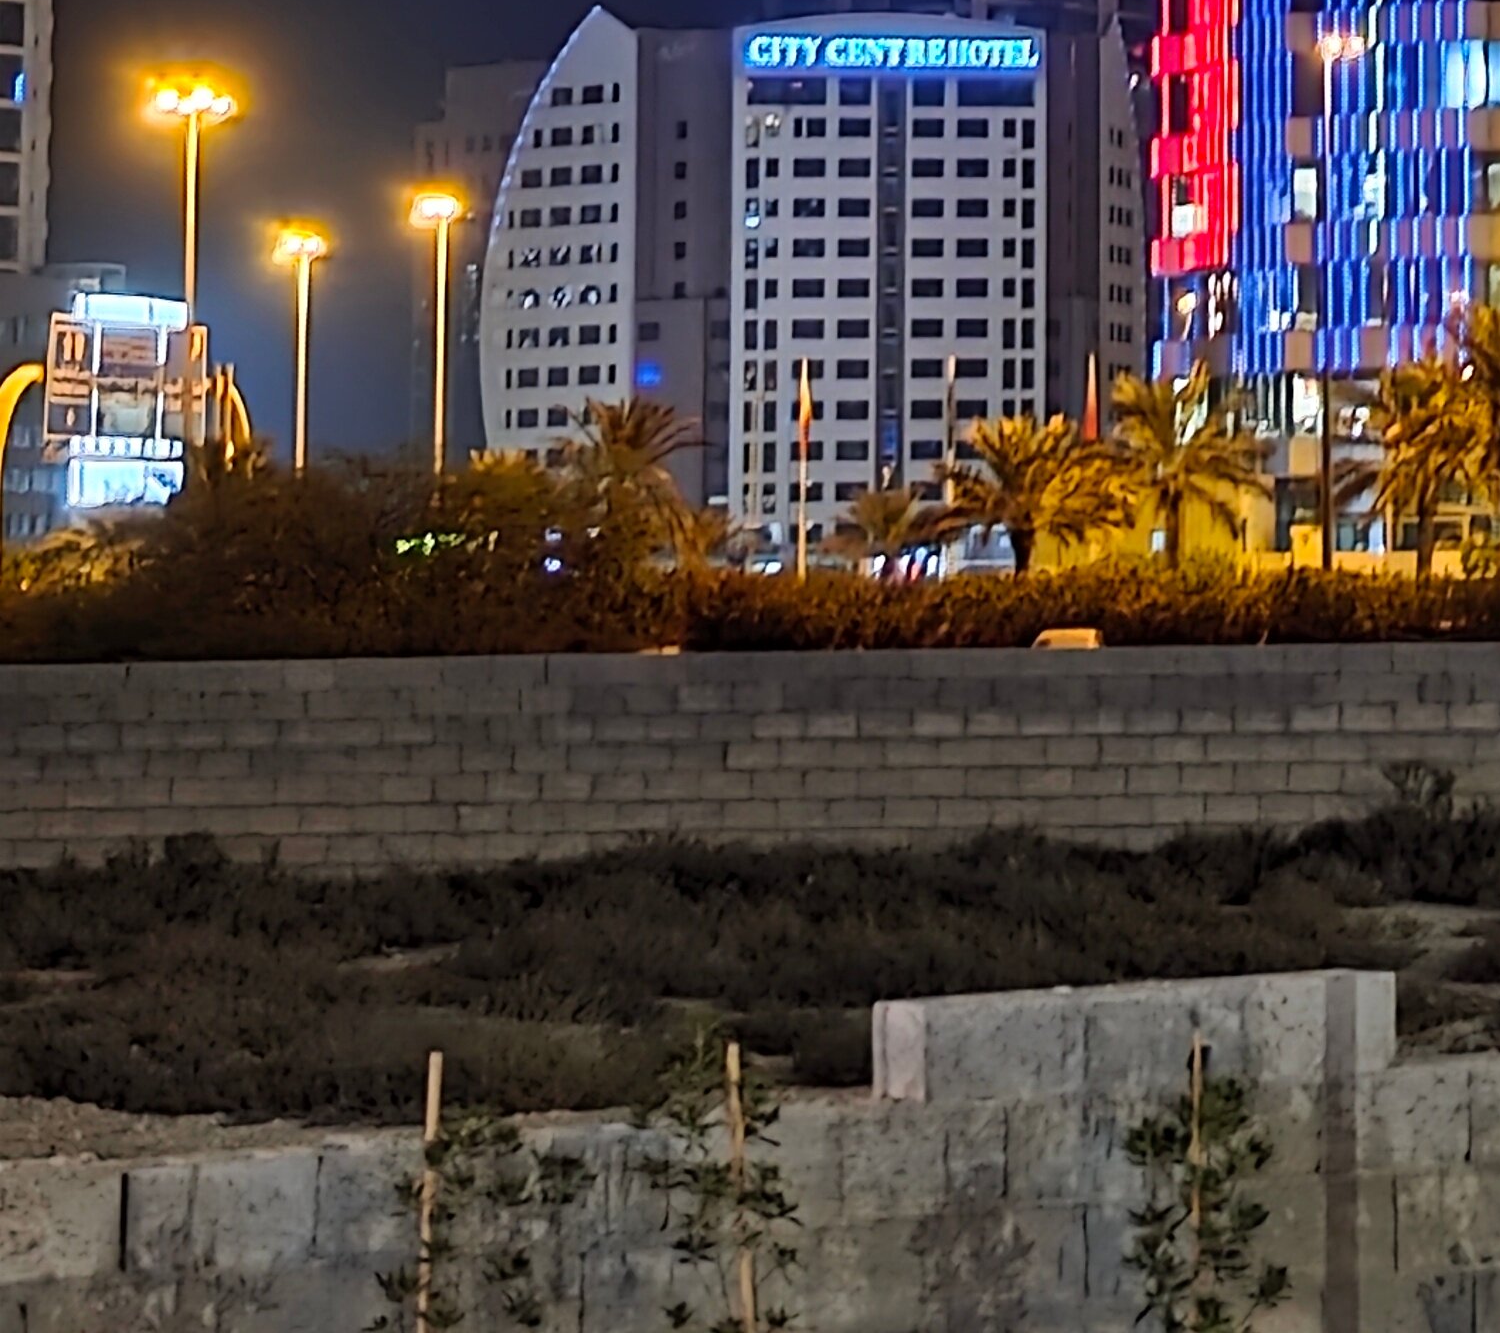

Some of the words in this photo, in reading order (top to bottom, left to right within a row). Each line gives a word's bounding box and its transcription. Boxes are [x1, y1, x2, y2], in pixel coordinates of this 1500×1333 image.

[748, 34, 823, 68] CITY
[824, 35, 946, 68] CENTRE
[946, 37, 1040, 69] HOTEL
